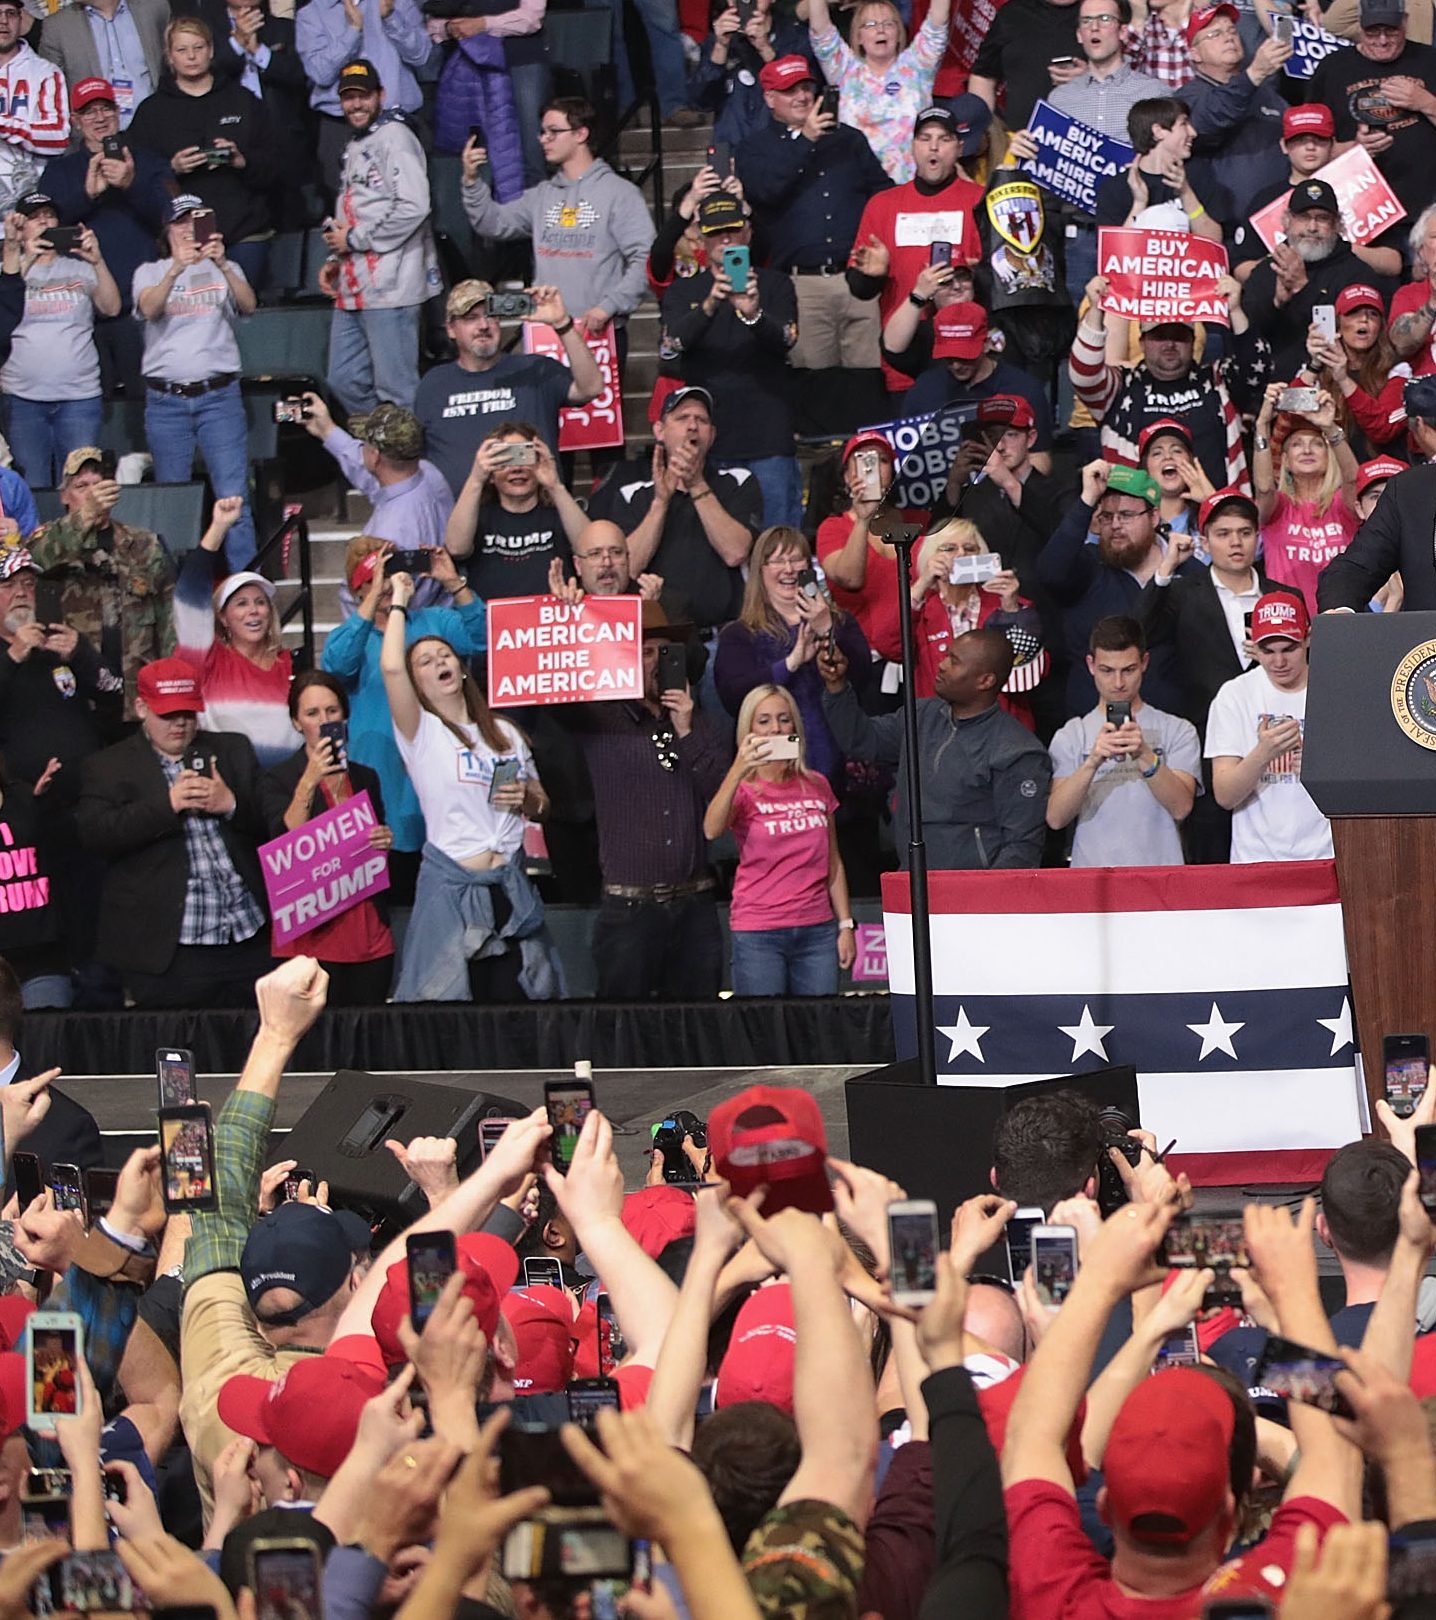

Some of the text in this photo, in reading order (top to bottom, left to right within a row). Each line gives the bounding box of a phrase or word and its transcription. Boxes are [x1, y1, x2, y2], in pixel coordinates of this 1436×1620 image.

[1031, 123, 1127, 178] AMERICA
[1067, 125, 1104, 153] BUY
[1024, 160, 1097, 205] AMERIC
[1056, 157, 1097, 188] HIRE
[1147, 239, 1190, 257] BUY
[1104, 256, 1228, 280] AMERICAN
[1142, 281, 1191, 298] HIRE
[1103, 296, 1229, 317] AMERICAN
[448, 387, 512, 406] FREEDOM
[442, 402, 479, 419] ISN'T
[484, 530, 554, 549] TRUMP
[540, 603, 586, 624] BUY
[1257, 604, 1296, 620] TRUMP
[495, 622, 635, 651] AMERICAN
[537, 649, 589, 670] HIRE
[496, 667, 635, 698] AMERICAN
[1407, 722, 1436, 746] SEAL
[265, 802, 374, 876] WOMEN
[0, 847, 38, 881] OVE
[311, 856, 342, 881] FOR
[274, 856, 387, 933] TRUMP
[260, 1272, 296, 1282] President
